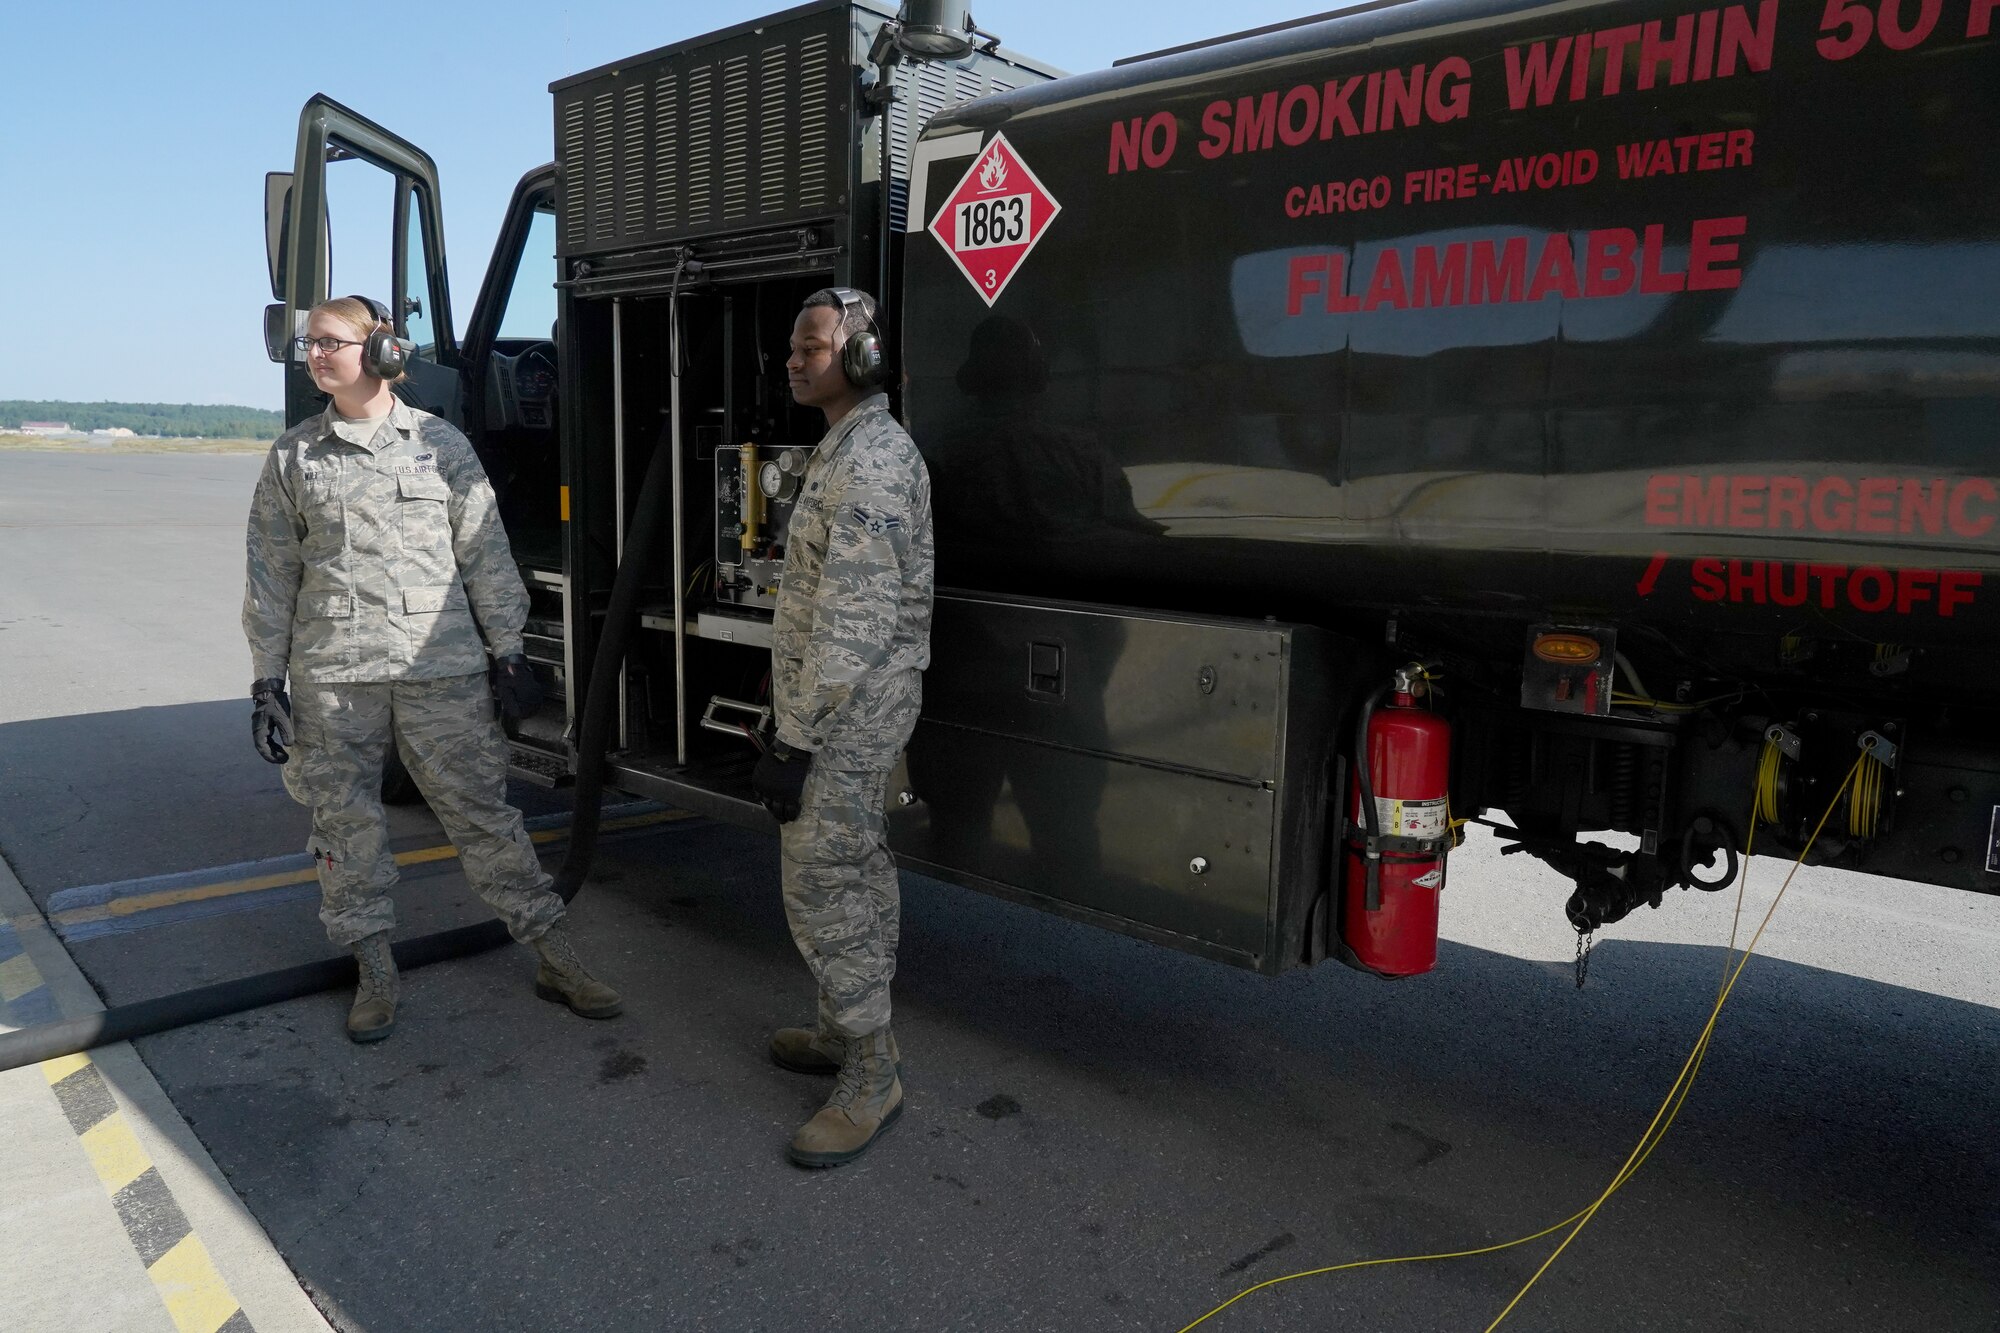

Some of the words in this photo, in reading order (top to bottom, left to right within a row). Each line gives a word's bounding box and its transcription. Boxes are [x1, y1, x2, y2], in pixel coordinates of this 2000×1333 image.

[1108, 112, 1178, 174] NO
[1198, 56, 1471, 159] SMOKING
[1504, 0, 1779, 110] WITHIN
[1816, 0, 1943, 60] 50
[1284, 176, 1392, 218] CARGO
[1404, 149, 1599, 205] FIRE-AVOID
[1616, 129, 1755, 180] WATER
[961, 197, 1024, 247] 1863
[985, 269, 997, 289] 3
[1287, 216, 1748, 317] FLAMMABLE
[1644, 475, 1998, 537] EMERGENC
[1691, 556, 1982, 617] SHUTOFF
[1394, 821, 1399, 829] B
[1395, 806, 1400, 814] A
